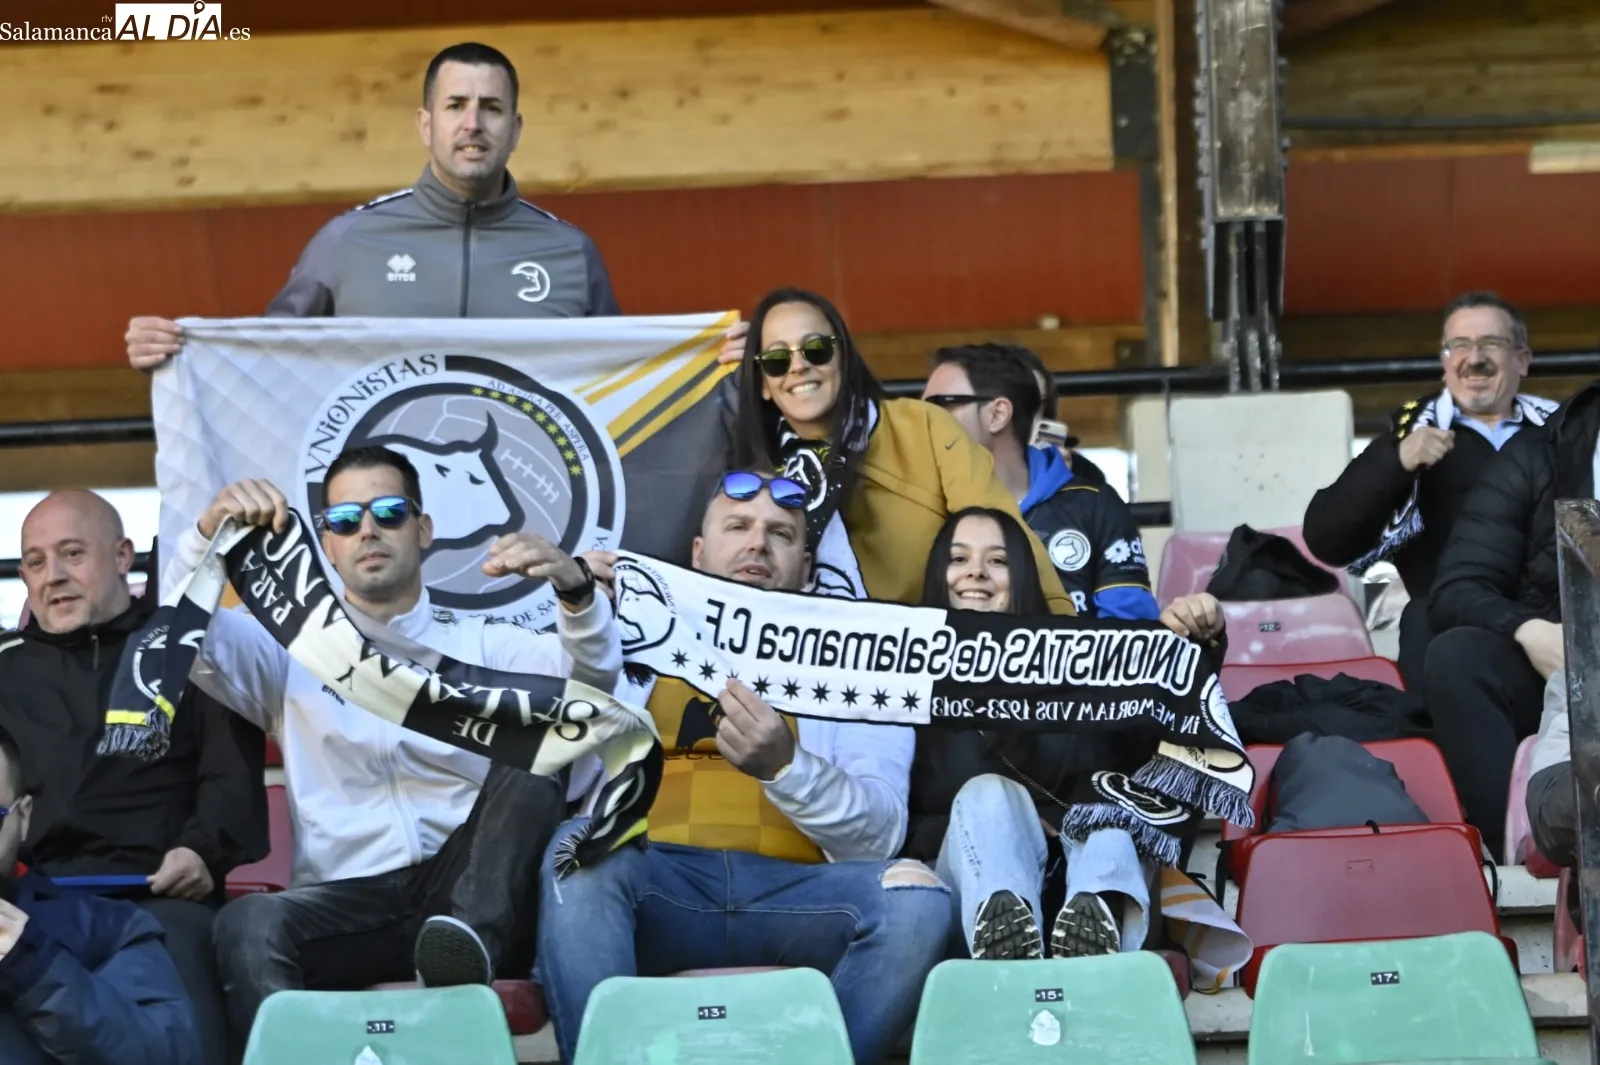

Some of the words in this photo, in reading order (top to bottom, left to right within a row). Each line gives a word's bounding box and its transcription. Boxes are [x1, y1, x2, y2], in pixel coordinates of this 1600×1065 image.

[488, 379, 506, 391] AD
[239, 548, 294, 627] PARA
[512, 610, 537, 626] DE
[452, 714, 500, 748] DE
[1375, 973, 1393, 984] 17
[1039, 990, 1058, 1001] 15
[702, 1007, 720, 1018] 13
